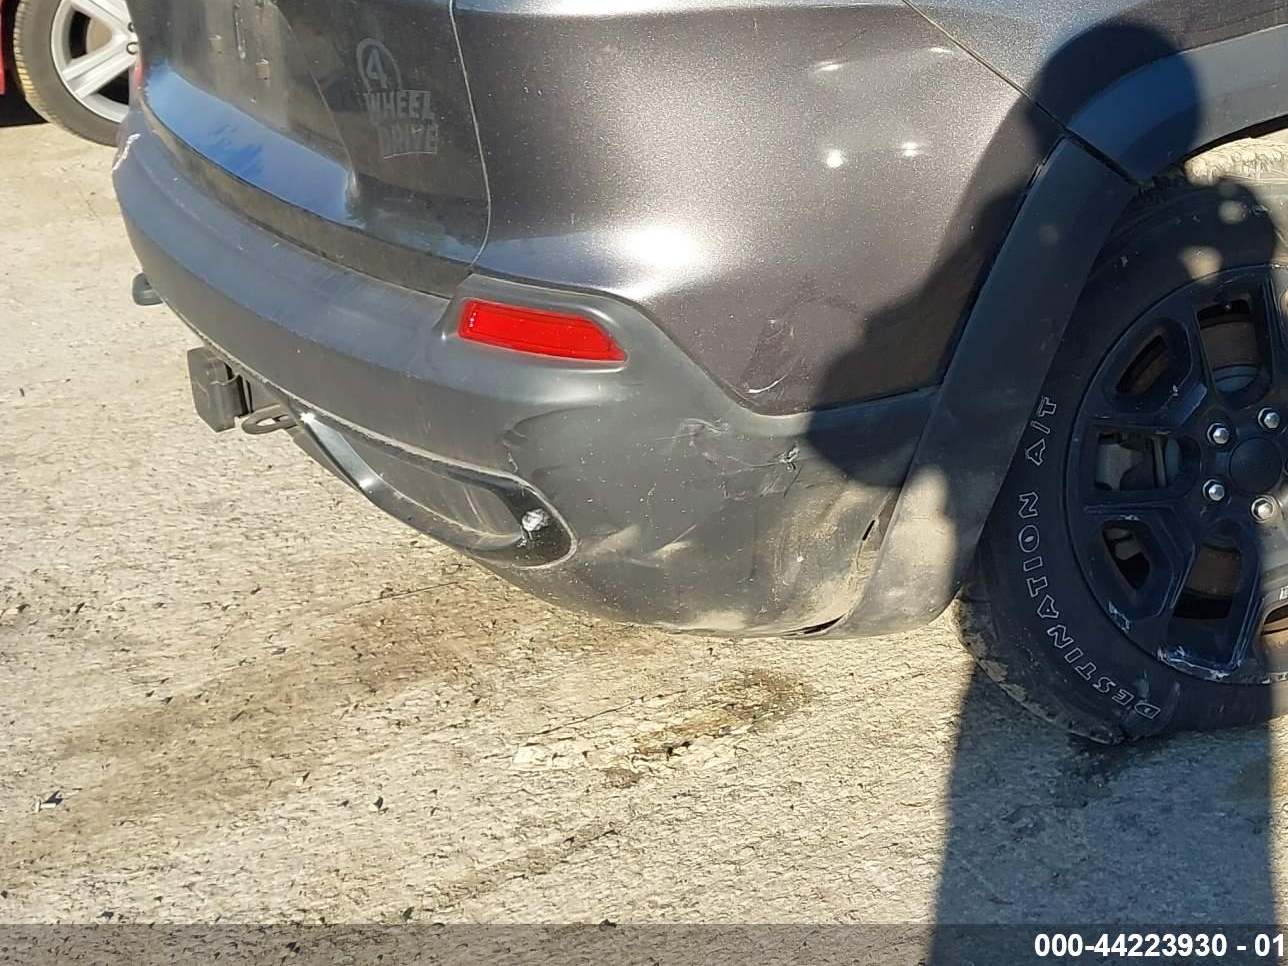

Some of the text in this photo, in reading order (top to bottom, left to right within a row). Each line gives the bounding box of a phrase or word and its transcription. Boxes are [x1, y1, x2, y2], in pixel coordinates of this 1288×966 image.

[364, 90, 435, 123] WHEEL
[1018, 396, 1161, 720] DESTINATION A/T
